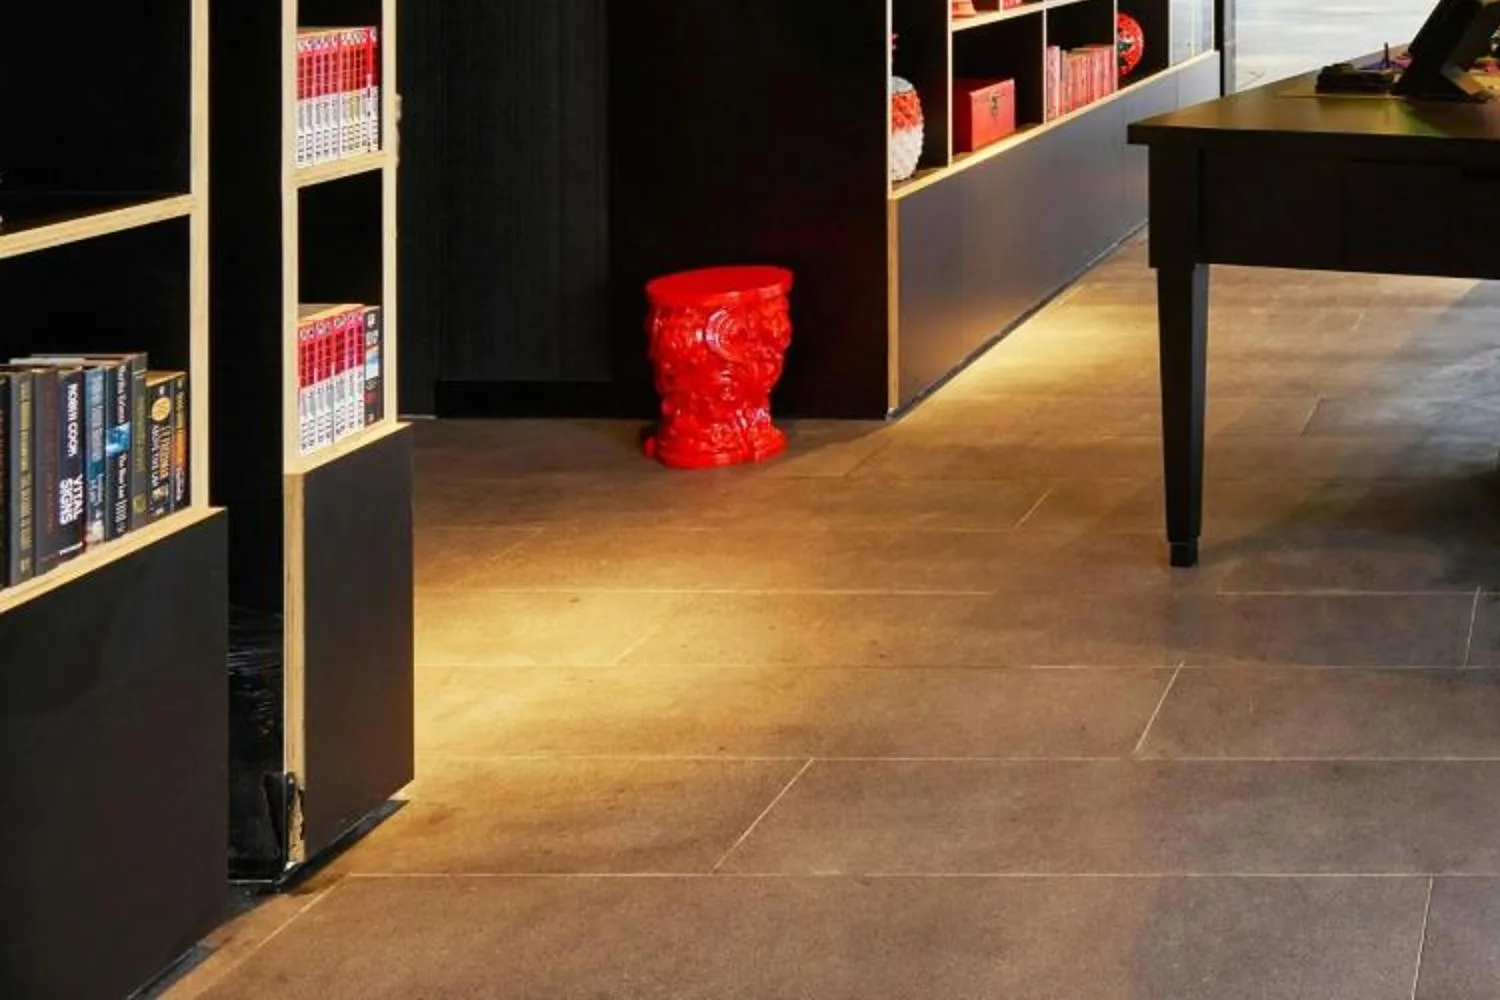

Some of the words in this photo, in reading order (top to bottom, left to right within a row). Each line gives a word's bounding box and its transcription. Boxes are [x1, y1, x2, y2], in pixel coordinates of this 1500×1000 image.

[66, 383, 79, 421] ROBIN
[66, 423, 78, 457] COOK
[59, 479, 72, 525] SIGNS
[71, 473, 84, 520] VITAL
